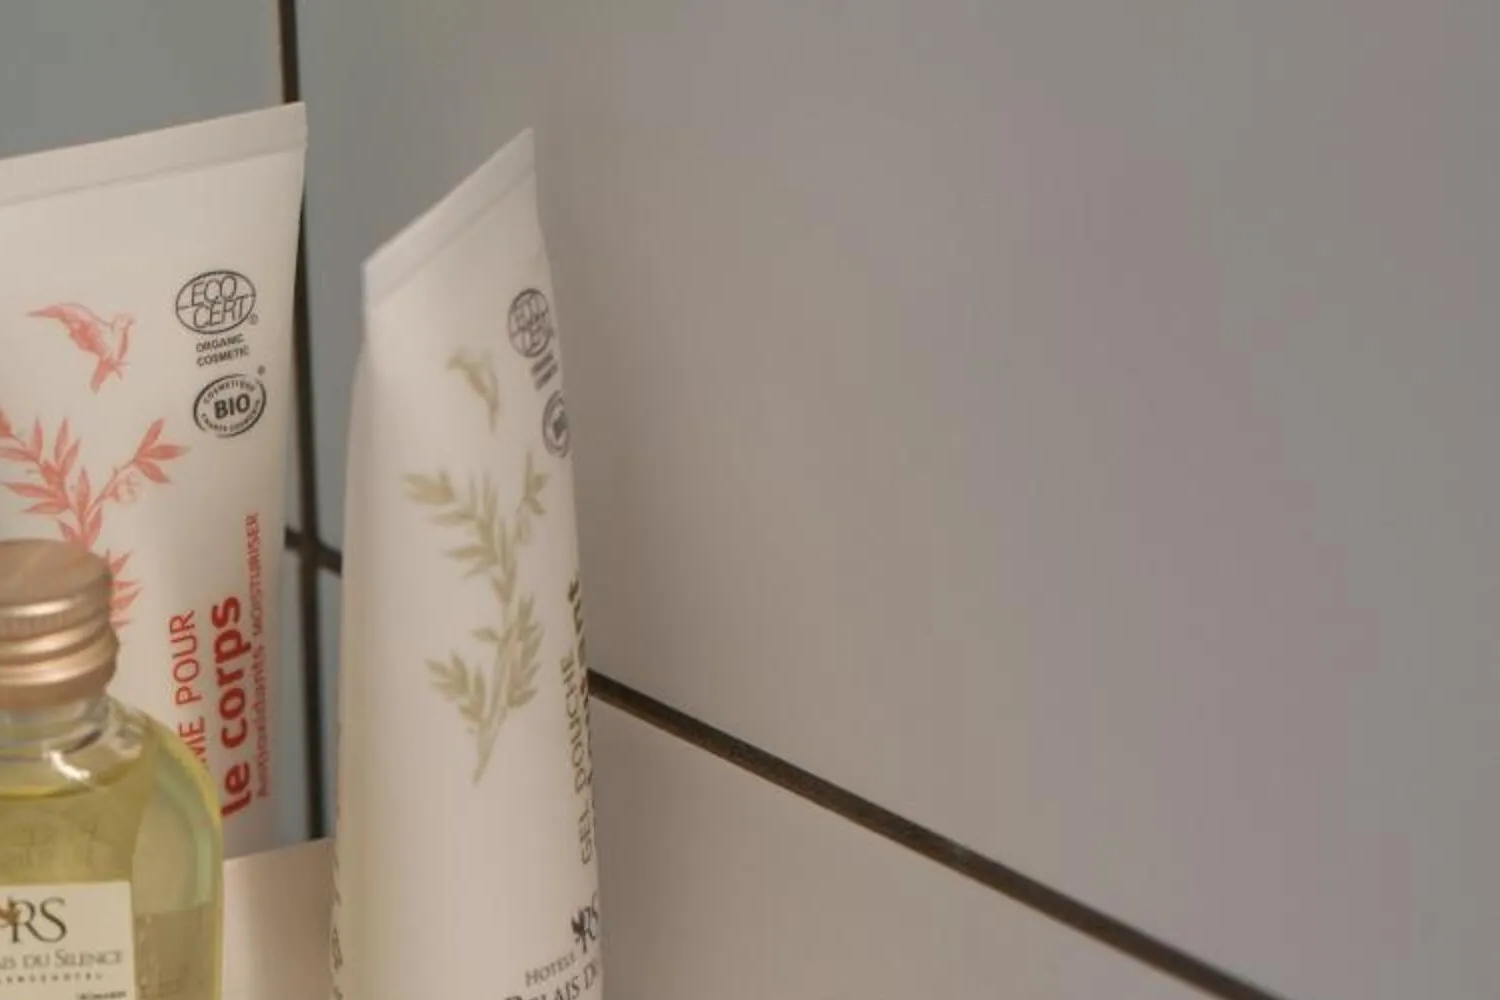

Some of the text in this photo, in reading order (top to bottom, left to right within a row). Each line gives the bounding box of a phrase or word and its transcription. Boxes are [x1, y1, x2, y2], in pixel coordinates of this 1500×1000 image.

[191, 274, 237, 307] ECO
[193, 296, 245, 328] CERT
[196, 333, 245, 353] ORGANIC
[196, 346, 250, 368] COSMETIC
[214, 393, 250, 419] BIO
[245, 512, 263, 637] MOISTURISER
[169, 608, 203, 706] POUR
[211, 596, 252, 818] le corps
[561, 656, 586, 794] DOUCHE
[6, 896, 68, 944] RS
[22, 953, 50, 970] DU
[54, 948, 123, 969] SILENCE
